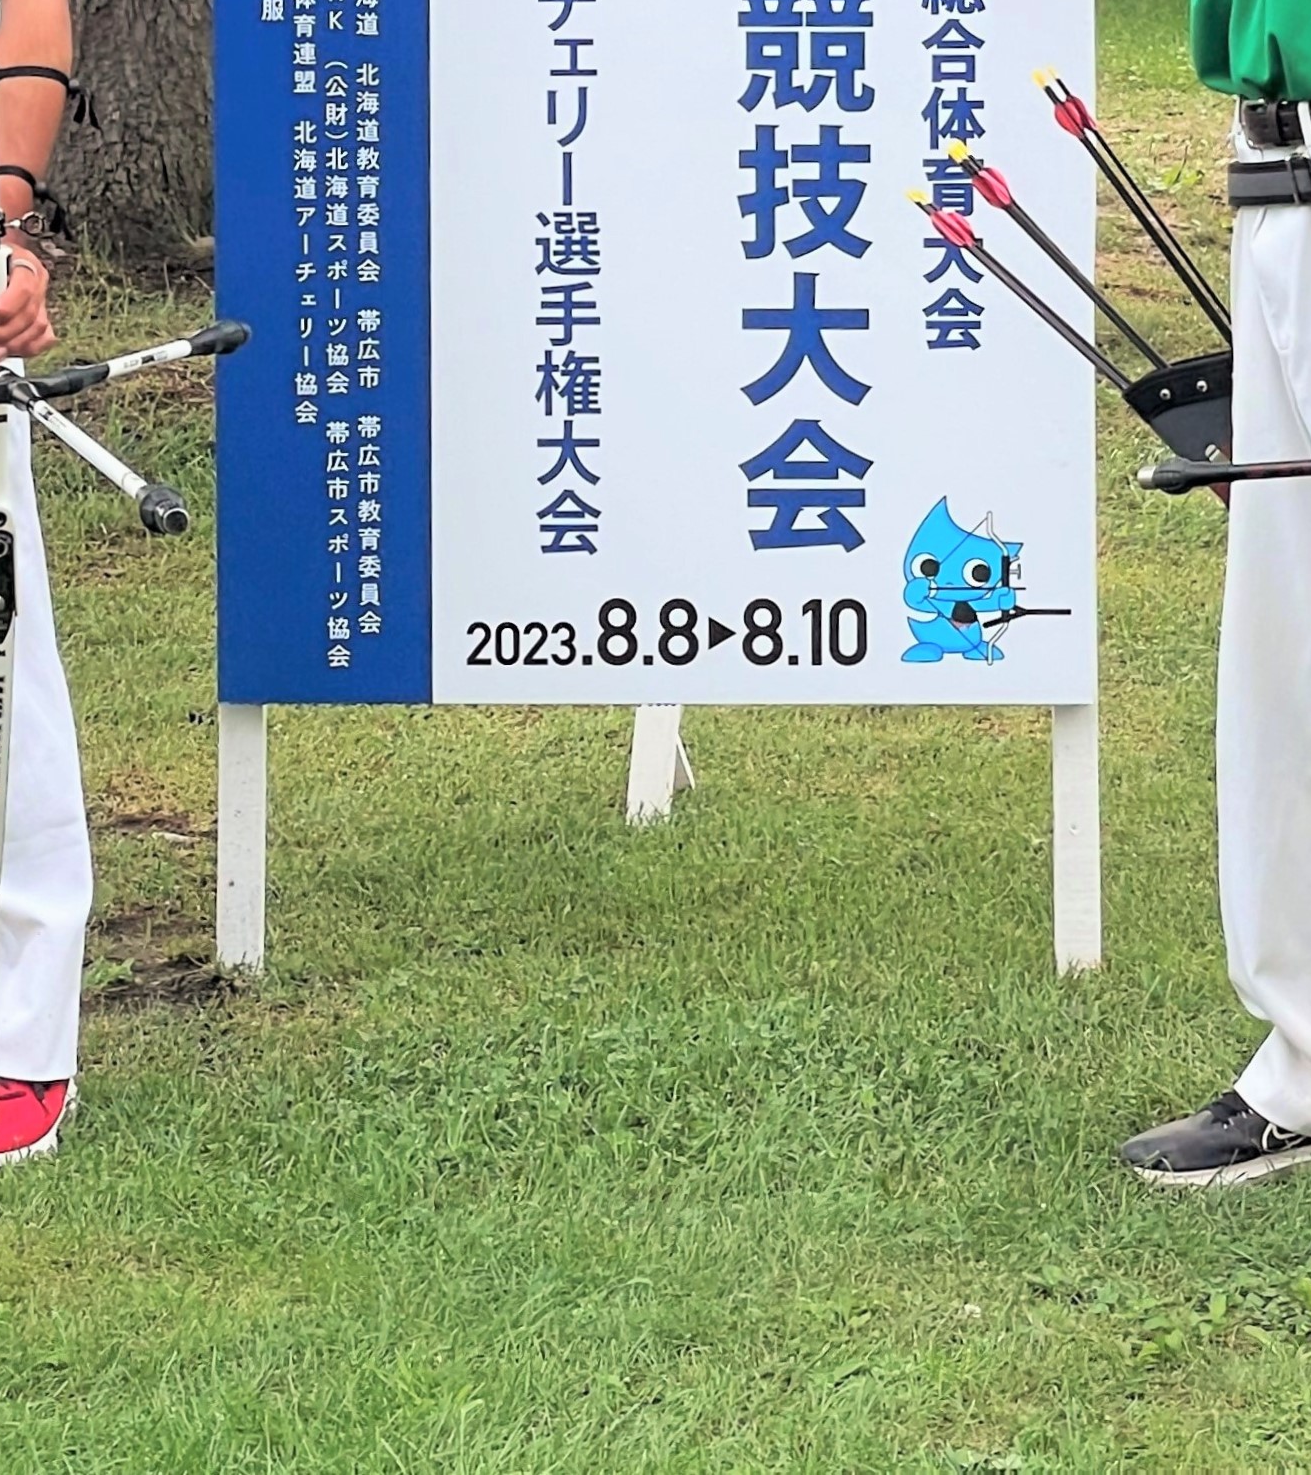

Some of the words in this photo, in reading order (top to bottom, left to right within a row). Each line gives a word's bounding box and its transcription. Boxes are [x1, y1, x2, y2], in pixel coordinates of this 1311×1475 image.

[357, 64, 380, 281] 北海道教育委員会
[358, 310, 380, 387] 帯広市
[327, 422, 350, 666] 帯広市スポーツ協会
[358, 416, 381, 633] 帯広市教育委員会
